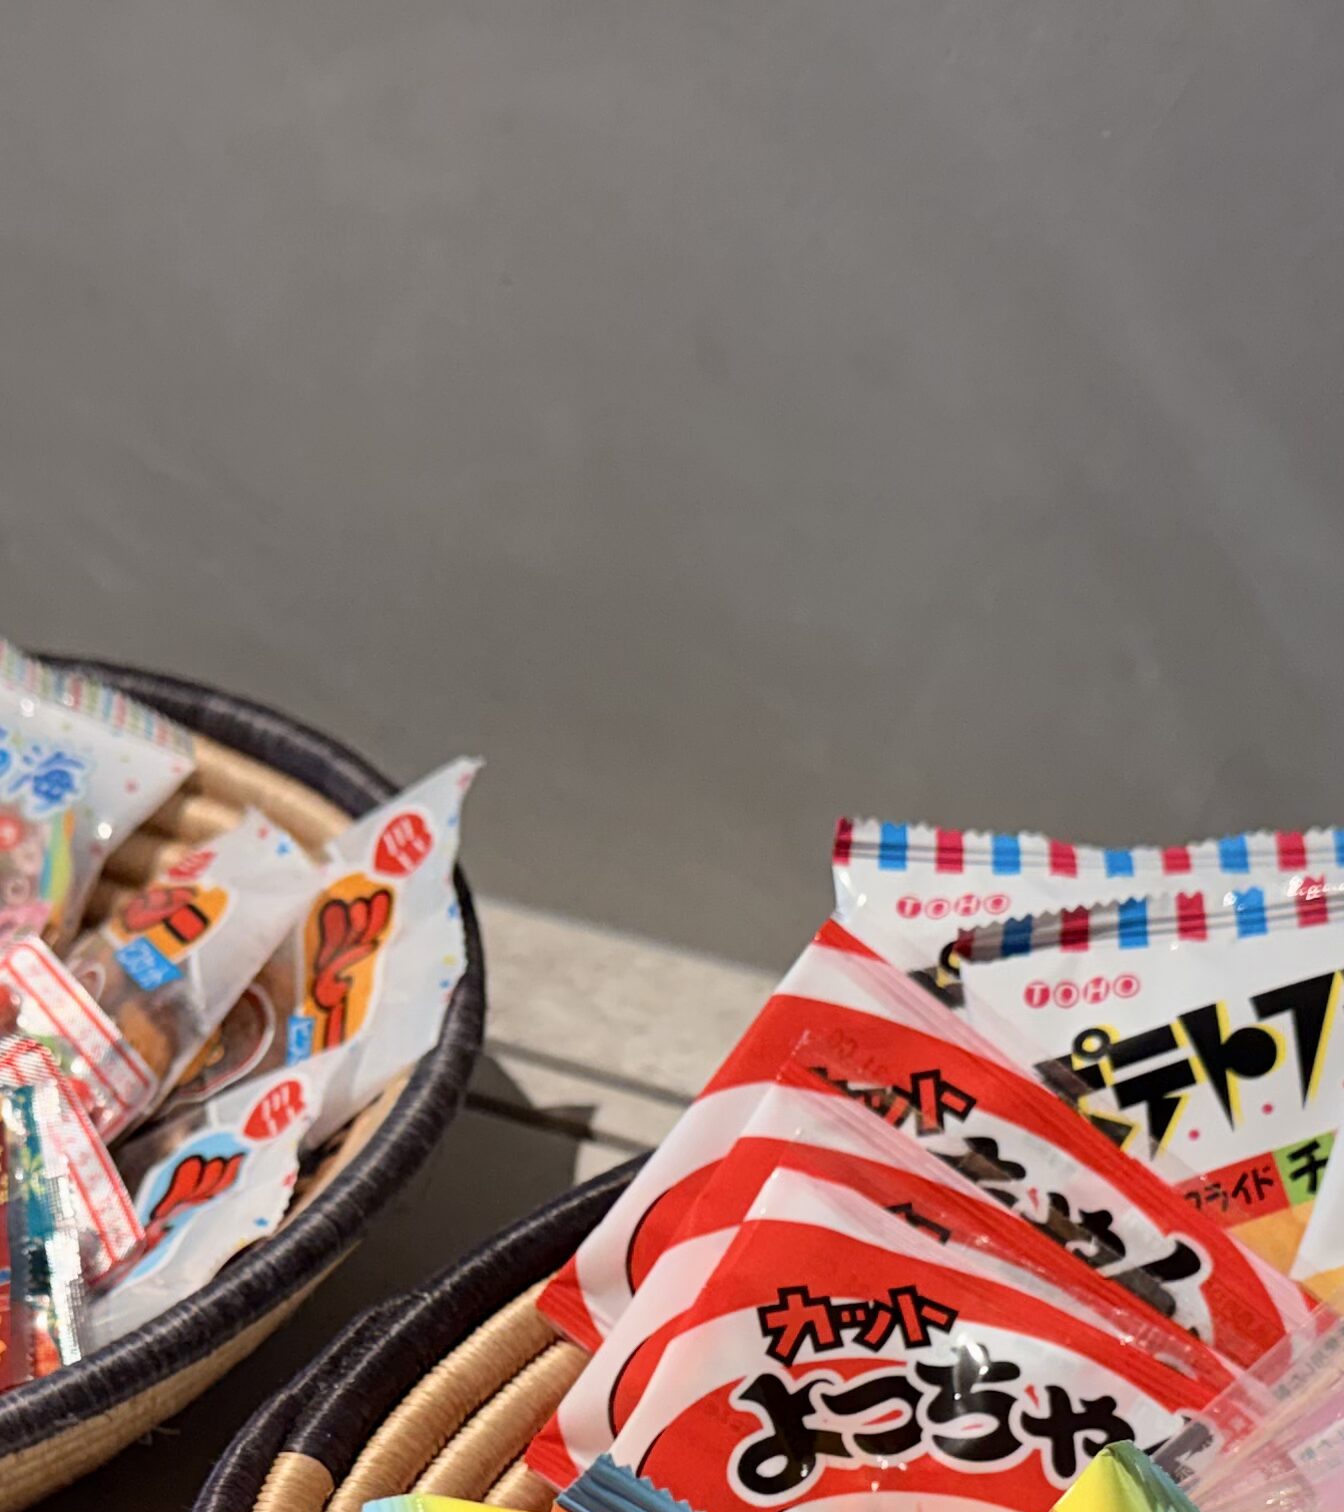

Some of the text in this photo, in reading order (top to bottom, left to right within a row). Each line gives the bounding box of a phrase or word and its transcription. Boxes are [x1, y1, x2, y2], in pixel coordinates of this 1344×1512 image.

[895, 892, 1012, 920] TOHO
[1022, 974, 1142, 1009] TOHO
[758, 1285, 959, 1362] カット
[735, 1341, 1171, 1502] よっちゃ
